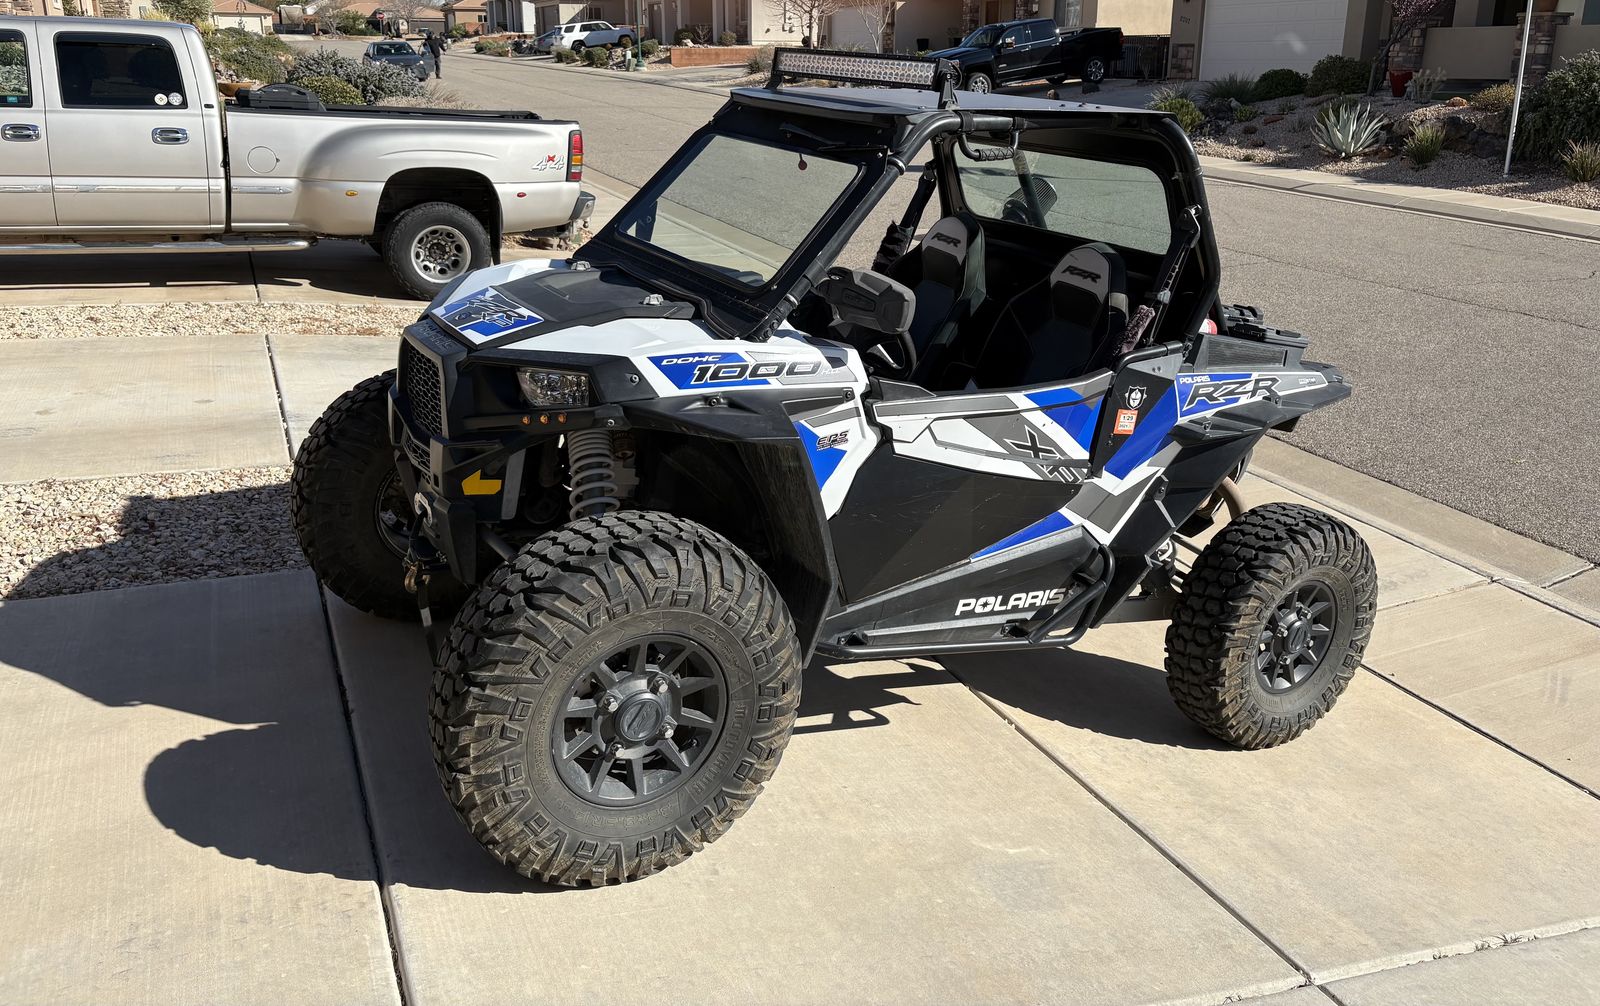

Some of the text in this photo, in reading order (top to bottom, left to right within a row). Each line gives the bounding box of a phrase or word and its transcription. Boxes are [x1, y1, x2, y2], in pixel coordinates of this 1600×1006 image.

[931, 232, 961, 248] RZR
[1061, 265, 1101, 283] RZR
[661, 355, 721, 365] DOHC
[690, 361, 822, 385] 1000
[1180, 376, 1211, 384] POLARIS
[1182, 376, 1281, 411] RZR
[816, 430, 849, 446] EPS
[954, 588, 1067, 616] POLARIS
